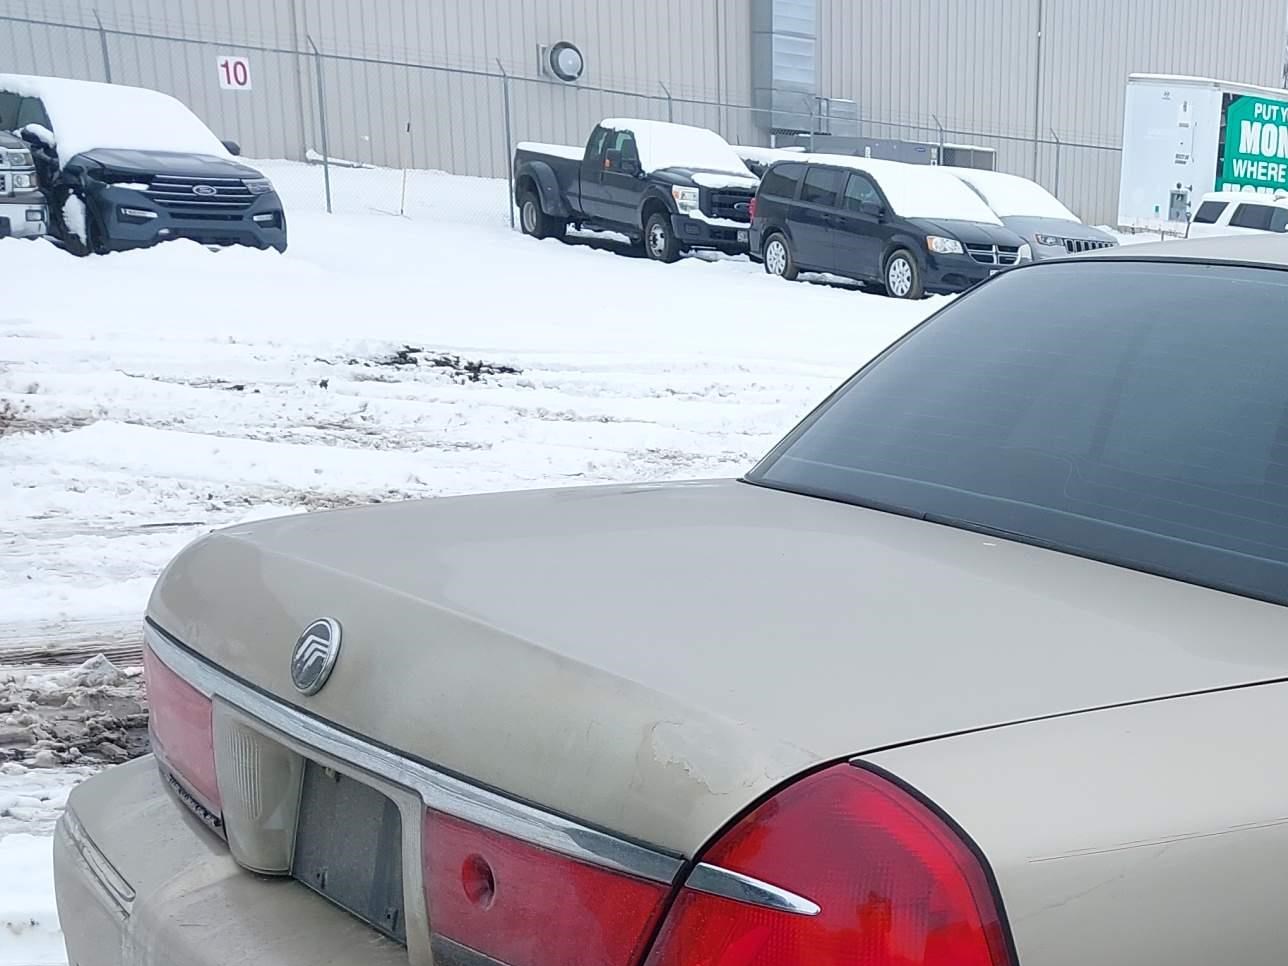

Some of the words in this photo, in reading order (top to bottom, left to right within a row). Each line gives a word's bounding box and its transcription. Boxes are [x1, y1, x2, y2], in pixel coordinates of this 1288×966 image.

[220, 59, 248, 86] 10
[1254, 102, 1280, 121] PUT
[1232, 158, 1287, 183] WHERE
